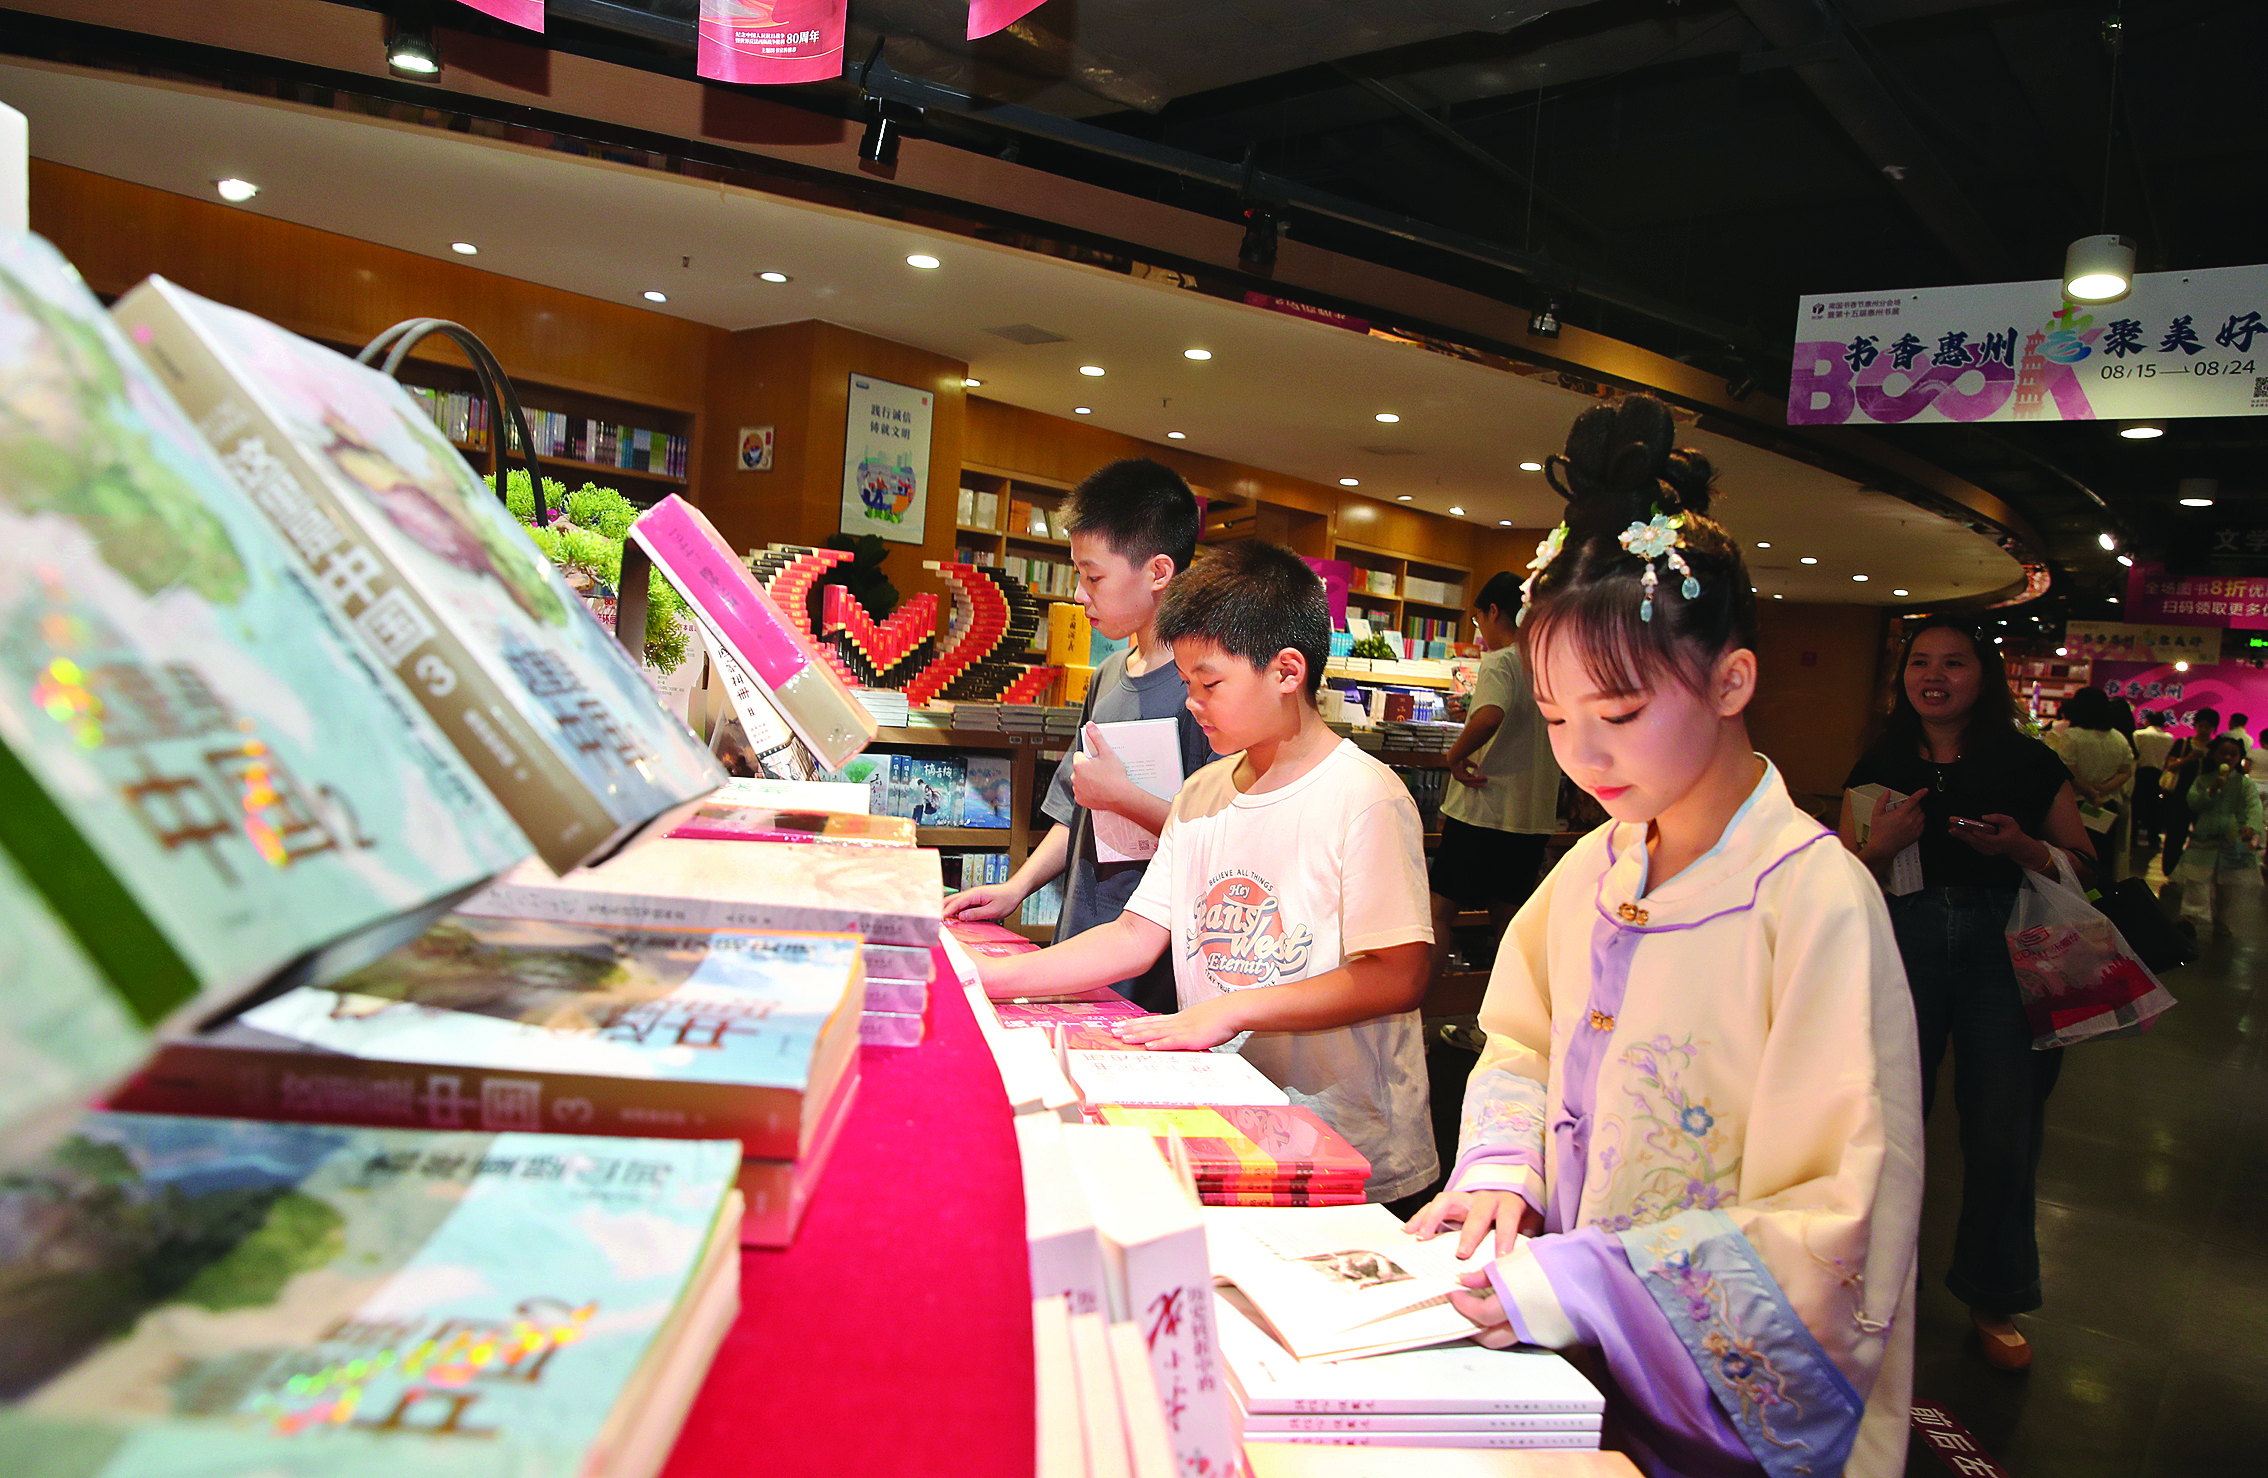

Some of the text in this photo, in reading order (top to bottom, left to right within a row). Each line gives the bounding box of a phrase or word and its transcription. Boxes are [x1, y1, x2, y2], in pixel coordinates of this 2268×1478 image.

[786, 29, 820, 45] 80周年
[1827, 307, 1900, 319] 暨第十五届惠州书展
[1842, 310, 2268, 371] 书香惠州 聚美好
[870, 403, 912, 424] 践行诚信
[2144, 579, 2268, 599] 全场图书8折优
[1208, 868, 1274, 892] BELIEVE ALL THINGS
[1228, 882, 1251, 899] Hey
[1231, 915, 1314, 977] West
[1207, 951, 1277, 983] Eternity
